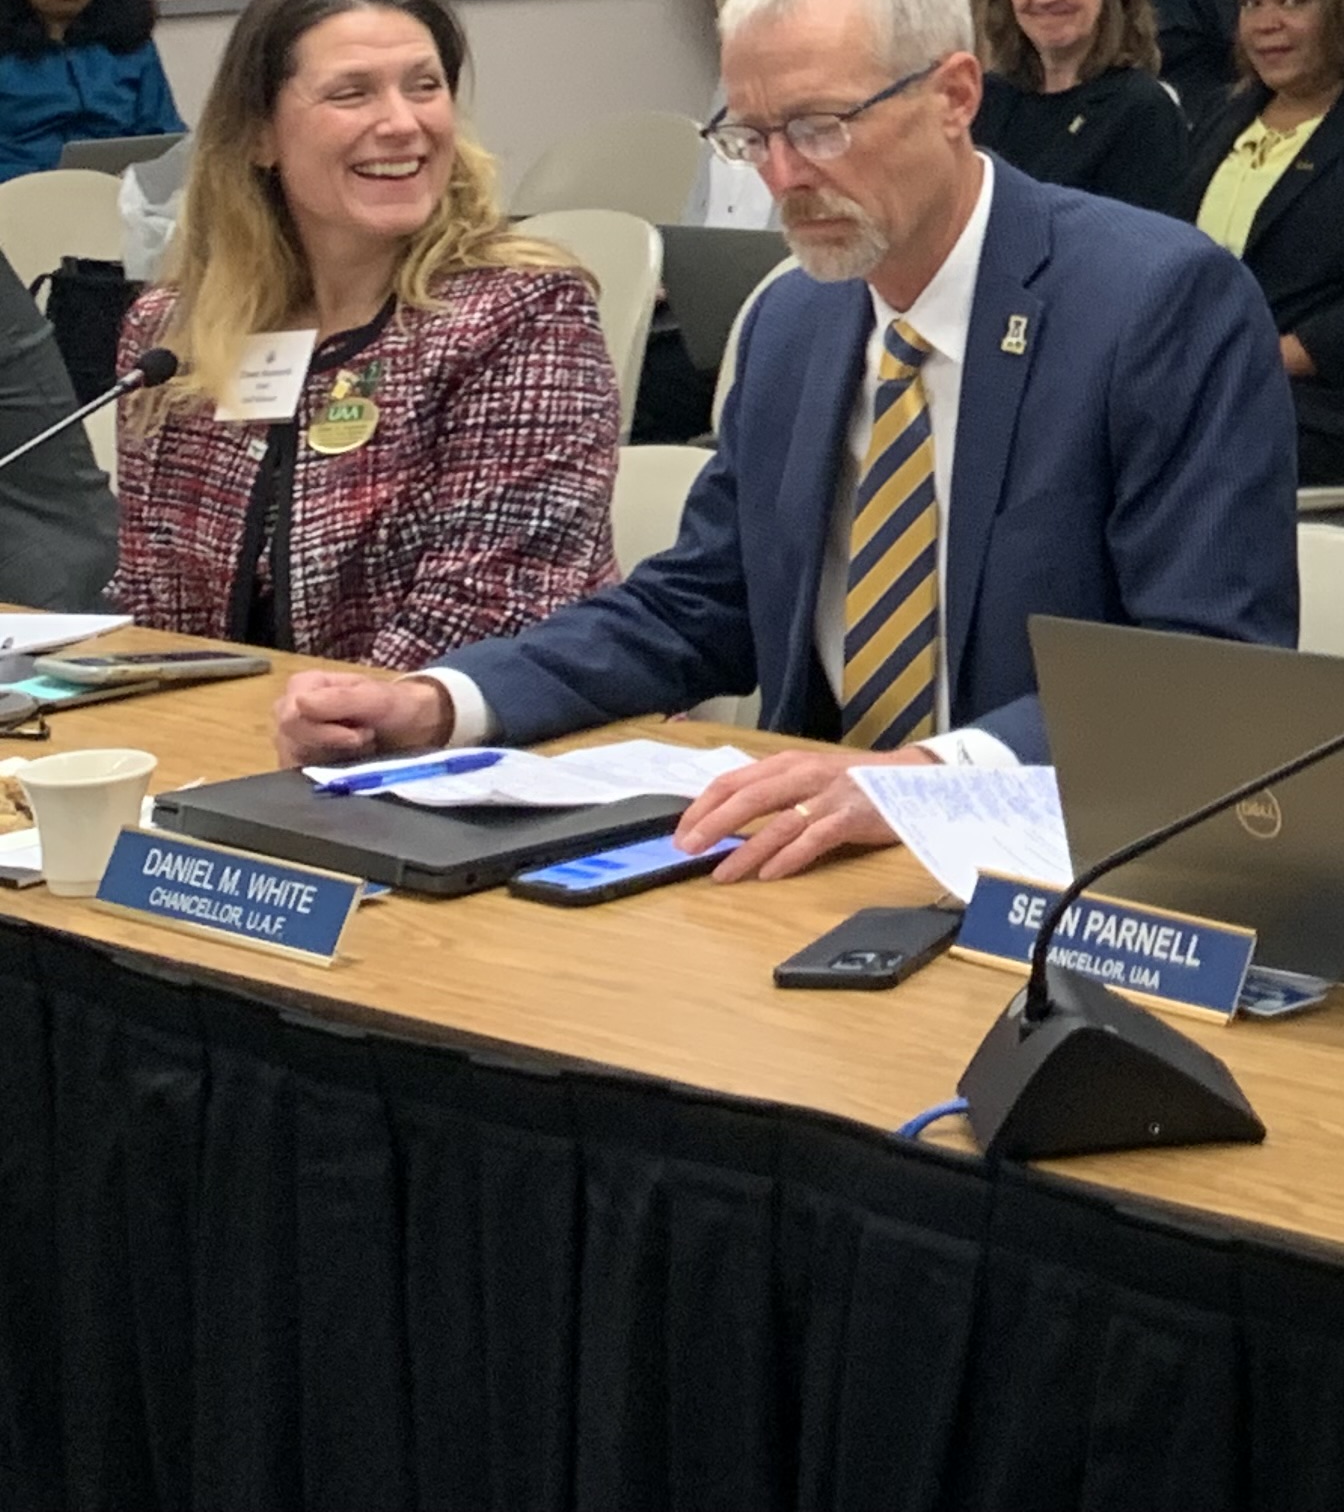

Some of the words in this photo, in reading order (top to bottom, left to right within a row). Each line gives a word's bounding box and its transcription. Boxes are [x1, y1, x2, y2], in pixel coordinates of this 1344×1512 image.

[142, 849, 214, 891] DANIEL
[217, 867, 240, 896] M.
[247, 872, 317, 914] WHITE
[149, 886, 243, 929] CHANCELLOR,
[1008, 893, 1082, 939] SEN
[1082, 910, 1201, 968] PARNELL
[1028, 942, 1126, 983] ANCELLOR,
[1129, 968, 1160, 989] UAA
